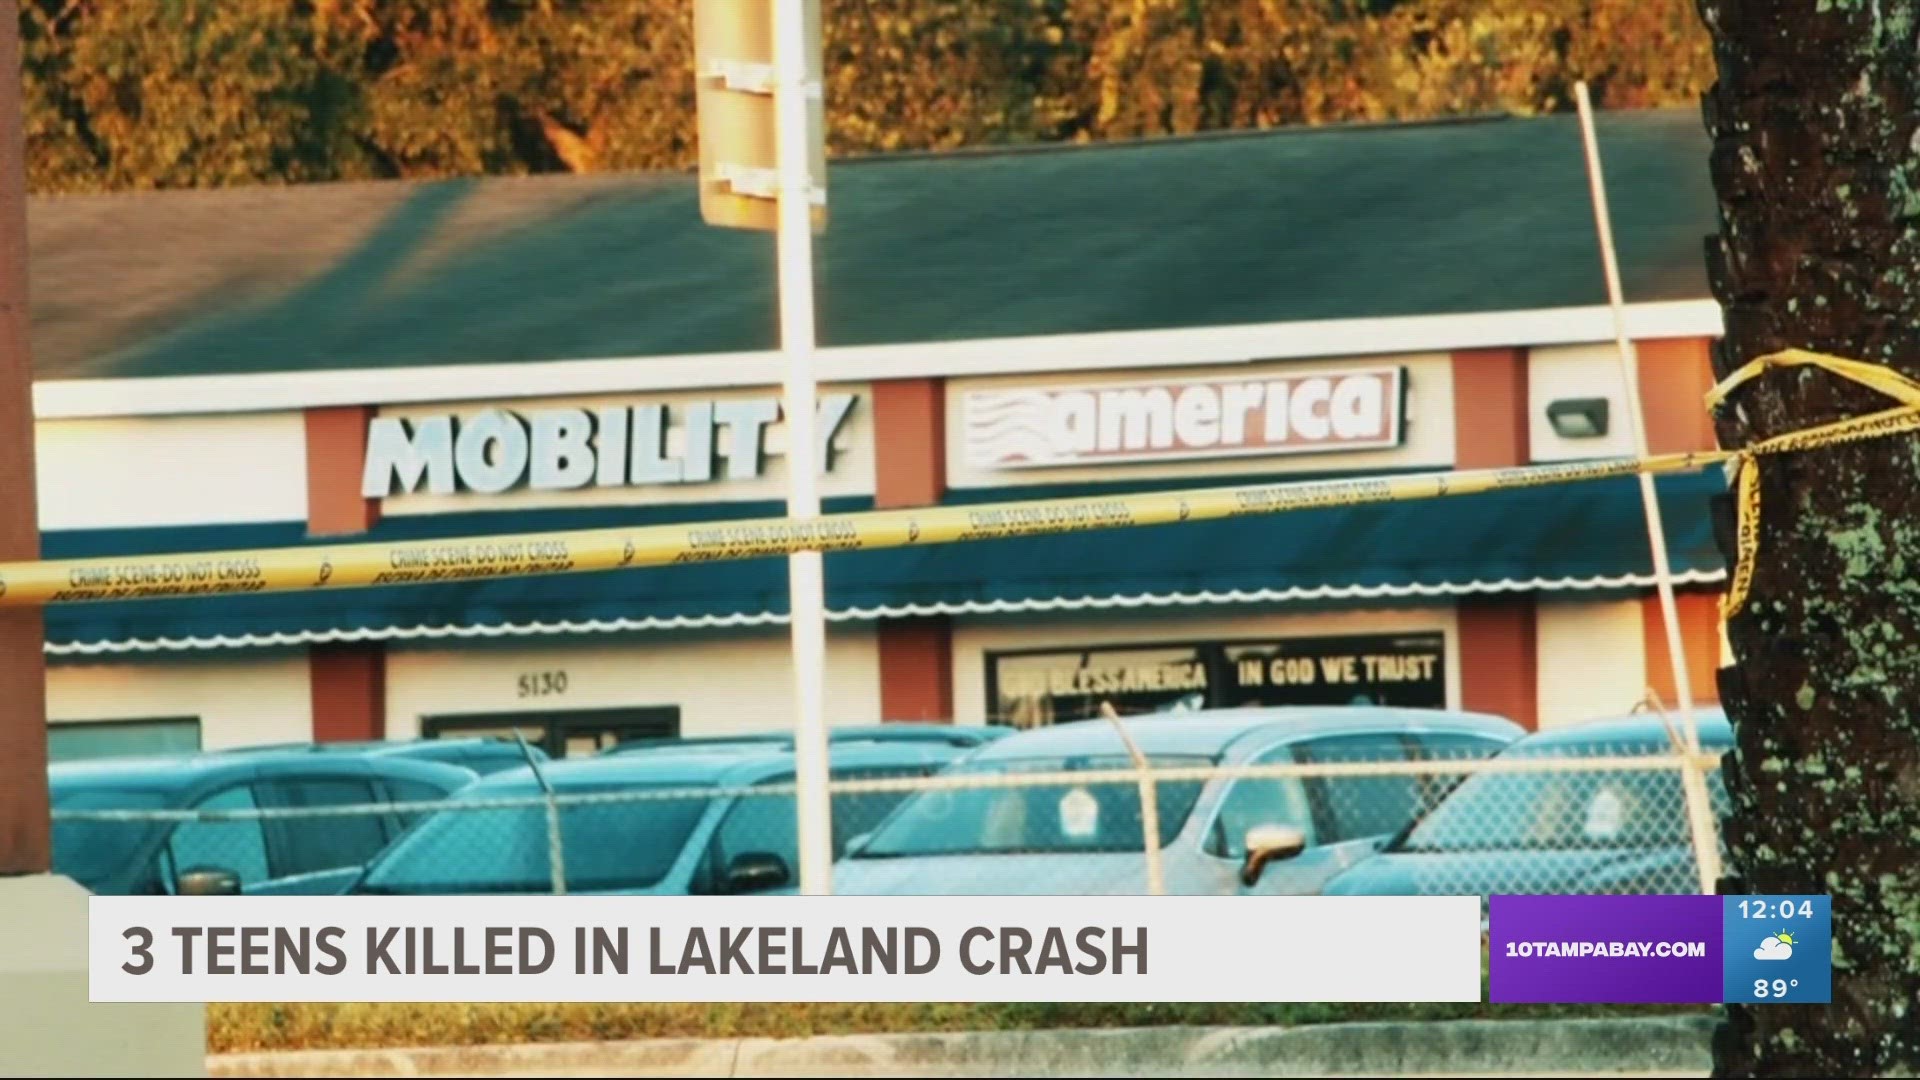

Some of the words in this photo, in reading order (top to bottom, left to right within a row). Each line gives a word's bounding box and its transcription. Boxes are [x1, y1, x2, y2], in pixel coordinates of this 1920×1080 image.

[1050, 374, 1384, 455] america
[389, 547, 430, 569] CRIME
[499, 543, 523, 562] NOT
[528, 541, 569, 561] CROSS
[69, 567, 112, 588] CRIME
[186, 561, 213, 582] NOT
[217, 558, 261, 580] CROSS
[517, 668, 569, 698] 5130
[1119, 662, 1208, 694] AMERICA
[1237, 659, 1263, 687] IN
[1270, 656, 1316, 685] GOD
[1320, 655, 1359, 683] WE
[1361, 653, 1438, 682] TRUST
